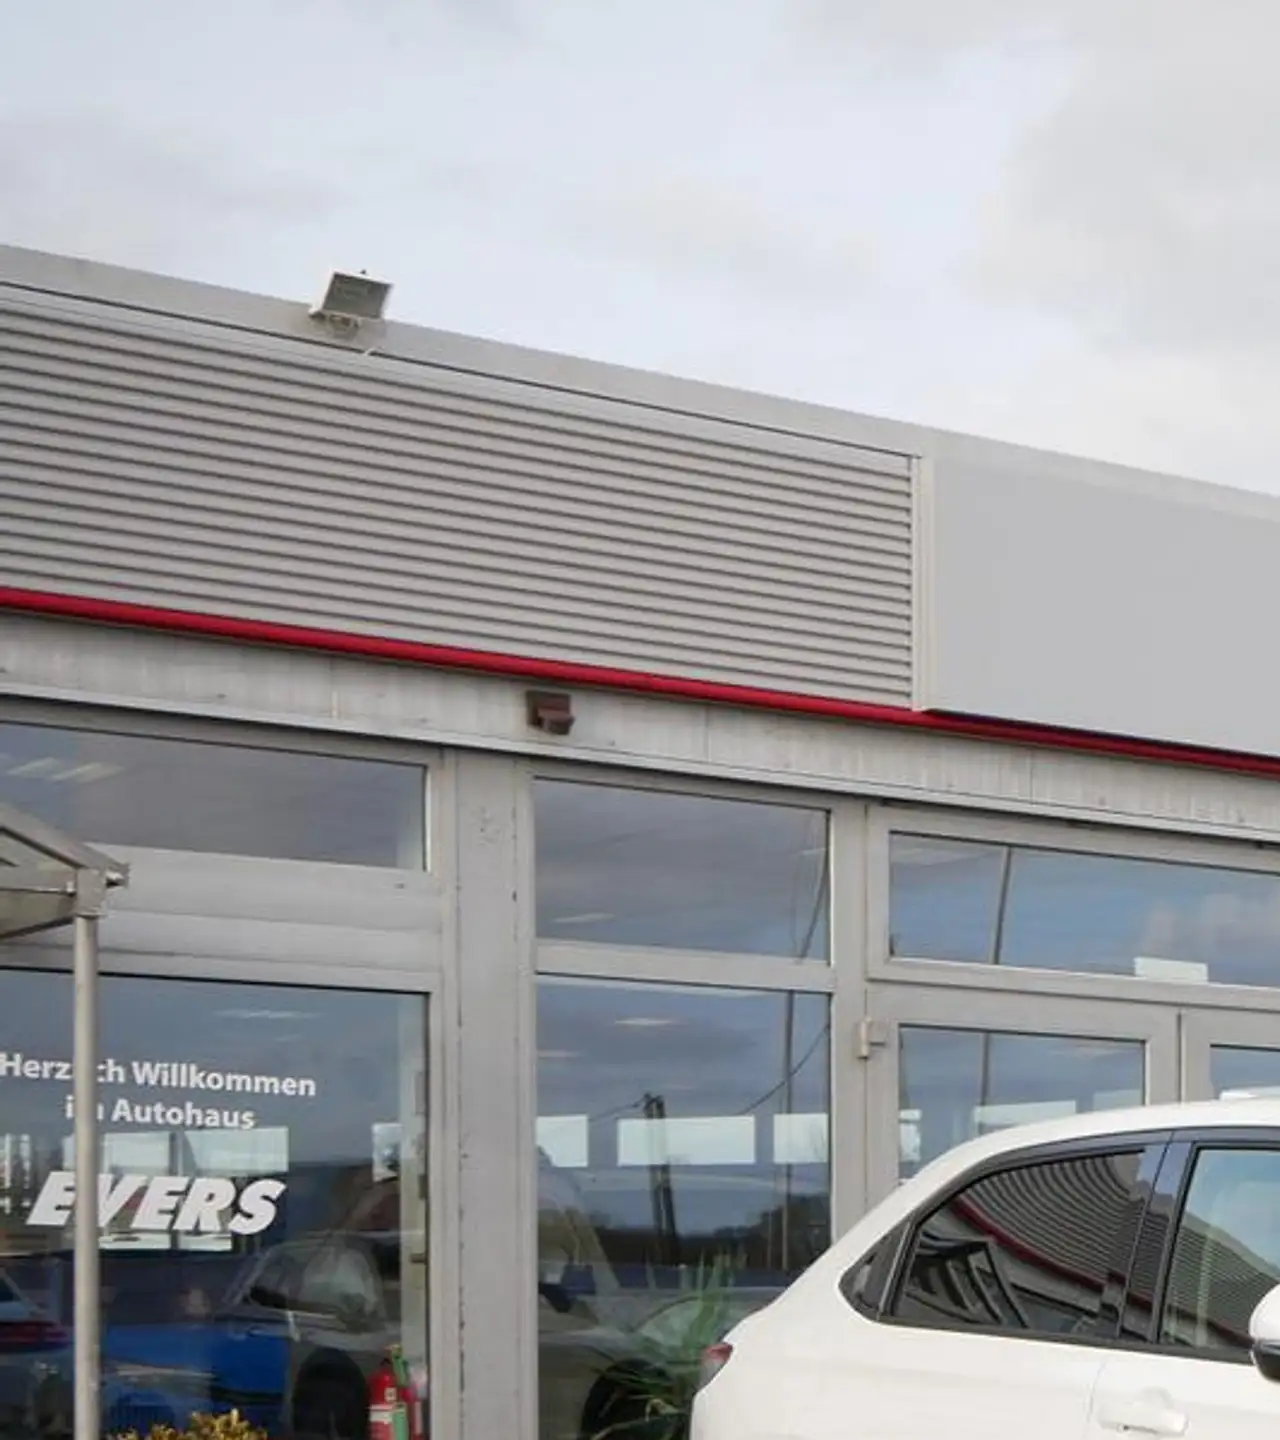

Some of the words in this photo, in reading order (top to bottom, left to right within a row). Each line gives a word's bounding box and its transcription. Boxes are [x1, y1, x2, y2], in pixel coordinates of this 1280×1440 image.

[131, 1060, 316, 1097] Willkommen
[65, 1094, 104, 1120] i
[111, 1099, 255, 1130] Autohaus
[26, 1170, 287, 1236] EVERS
